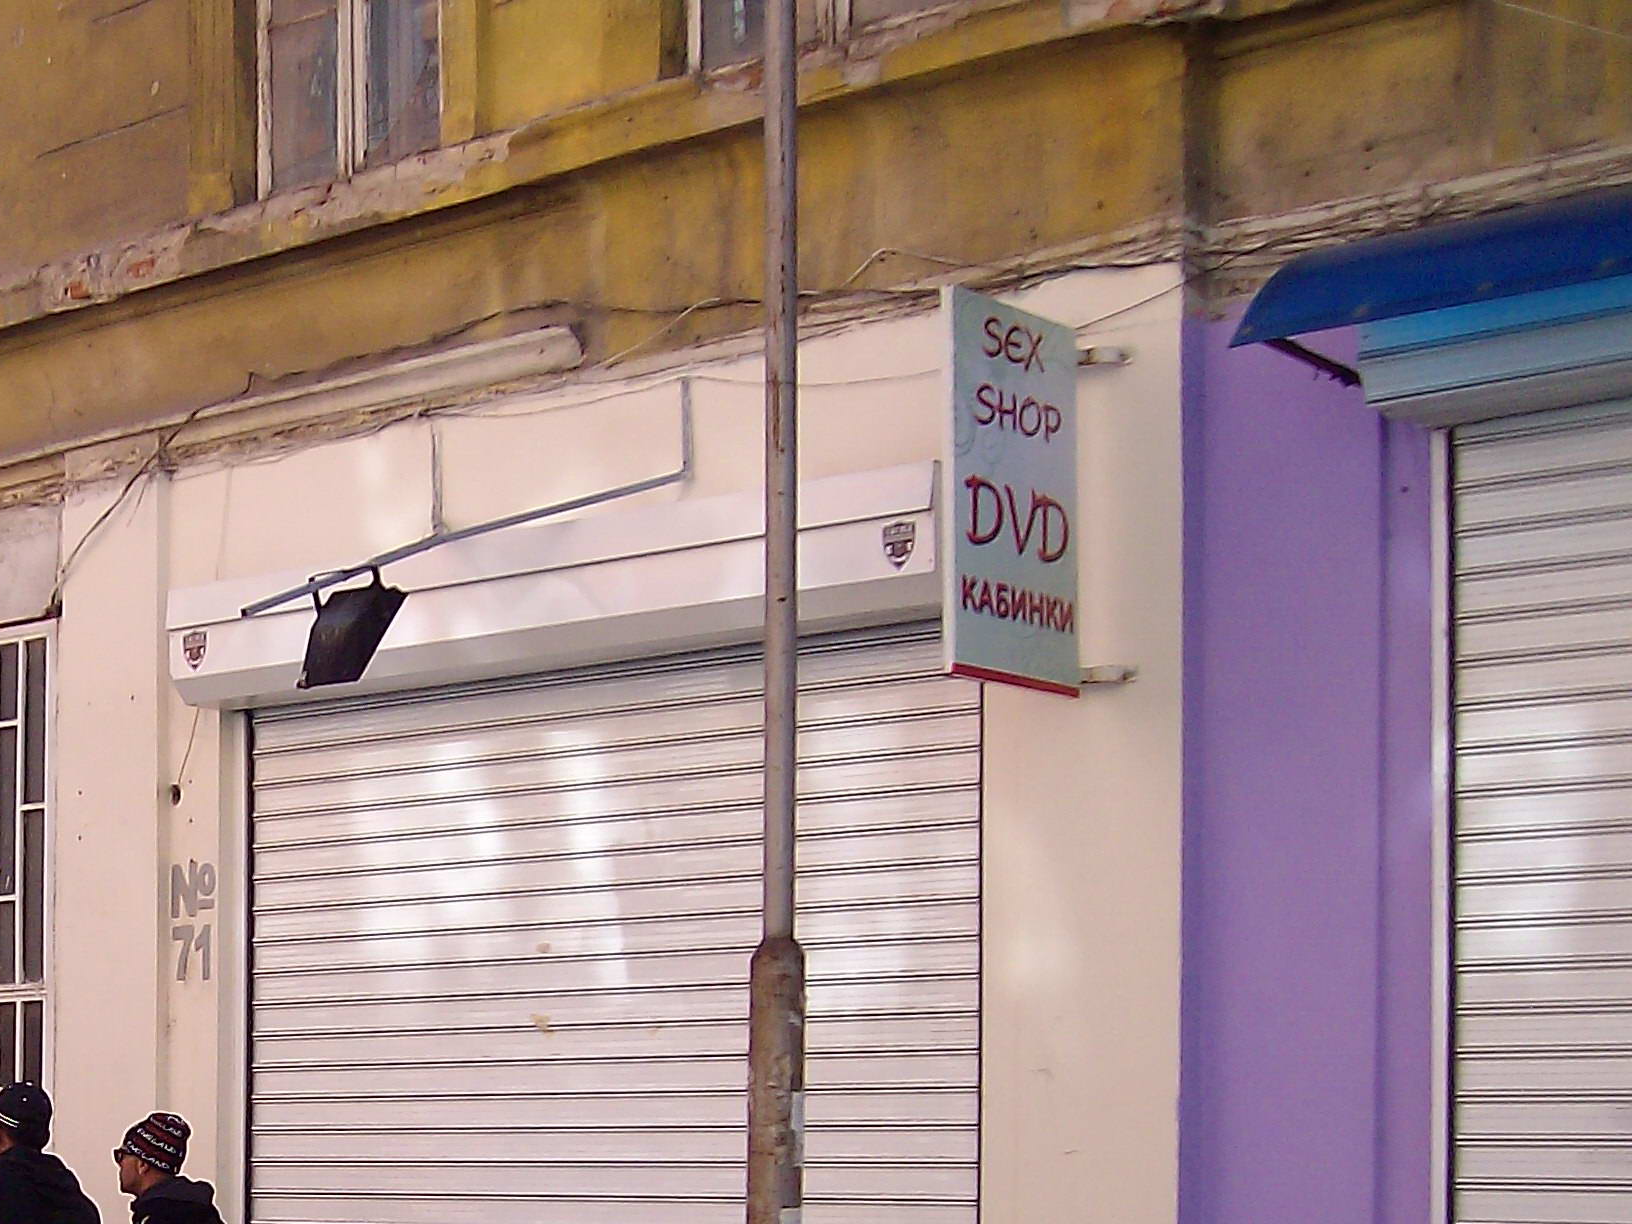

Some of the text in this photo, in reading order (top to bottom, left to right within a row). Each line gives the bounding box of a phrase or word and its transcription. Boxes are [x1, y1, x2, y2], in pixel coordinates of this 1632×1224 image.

[982, 316, 1045, 374] SEX
[974, 382, 1062, 443] SHOP
[965, 474, 1070, 563] DVD
[961, 574, 1075, 634] КАБИНКИ
[172, 924, 211, 981] 71
